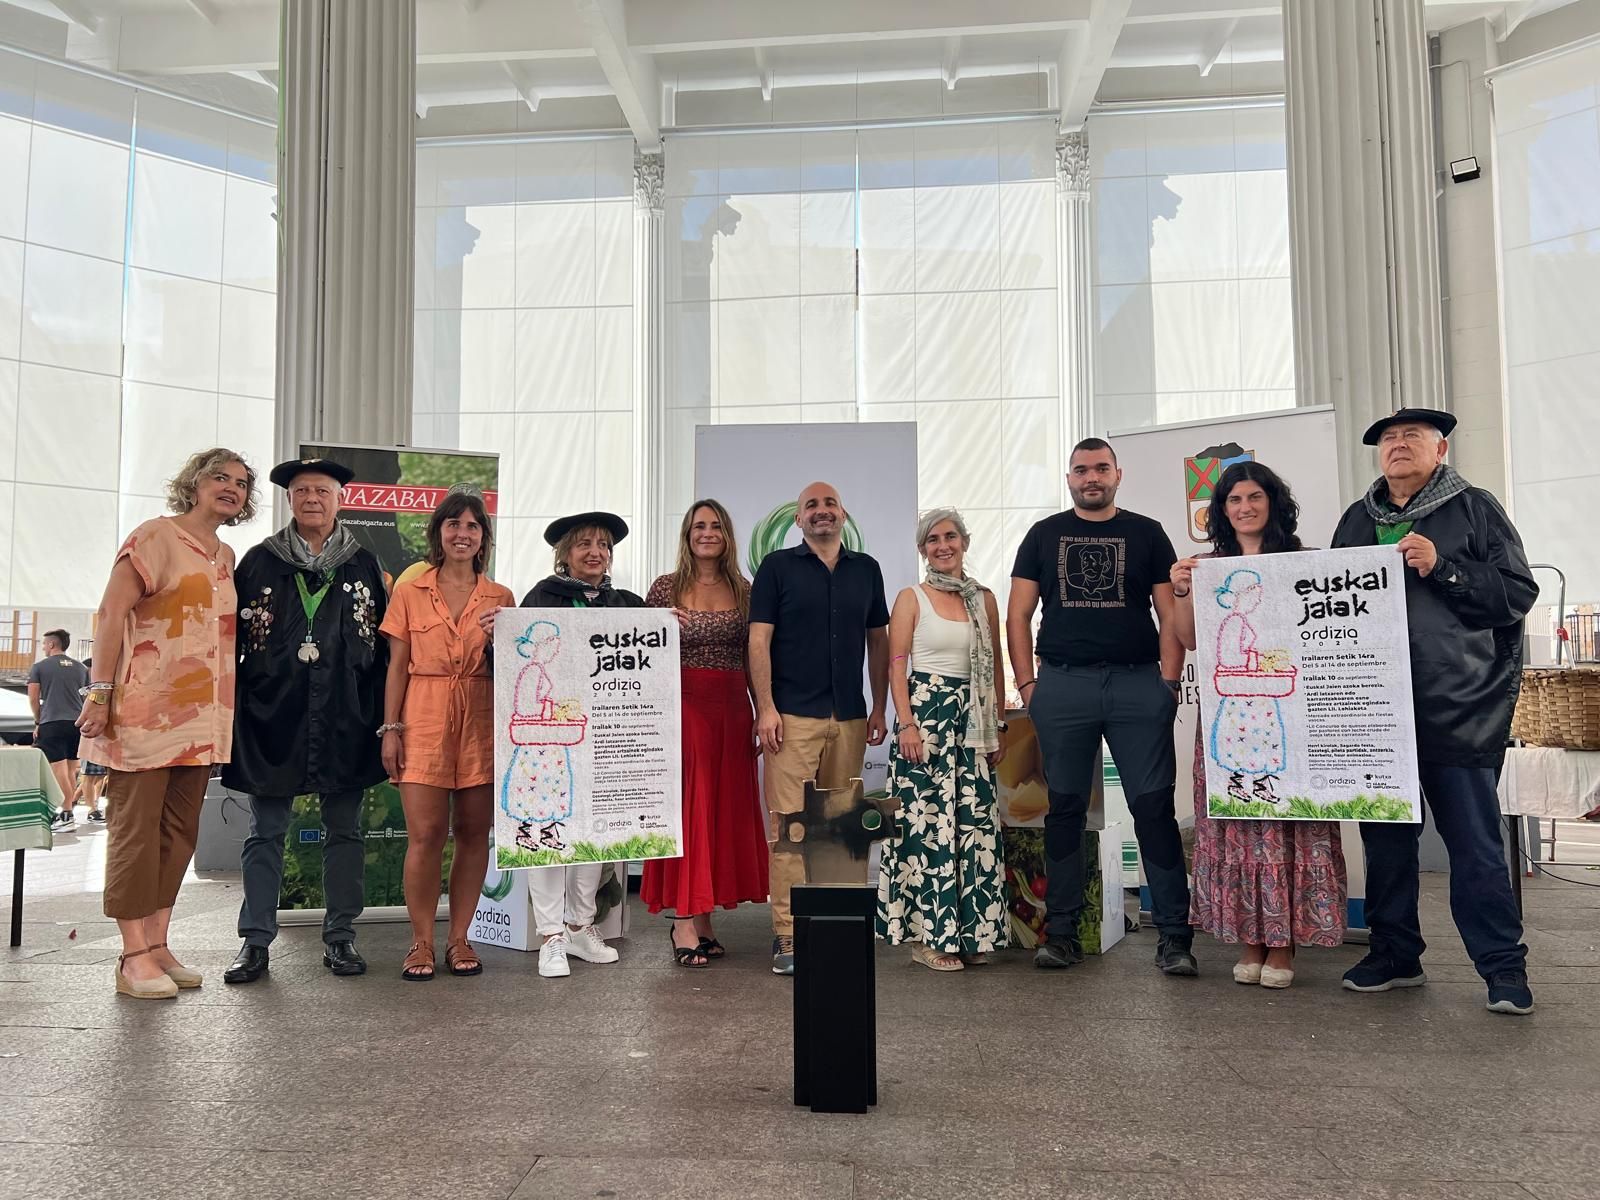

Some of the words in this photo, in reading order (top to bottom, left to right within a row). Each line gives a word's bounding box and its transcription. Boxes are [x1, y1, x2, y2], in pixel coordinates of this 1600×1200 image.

[1294, 567, 1387, 595] euskal
[1298, 593, 1369, 626] jaiak
[589, 626, 666, 649] euskal
[1301, 626, 1357, 640] ordizia
[590, 649, 651, 677] jaiak
[592, 678, 641, 690] ordizia
[476, 907, 510, 926] ordizia
[475, 925, 510, 943] azoka
